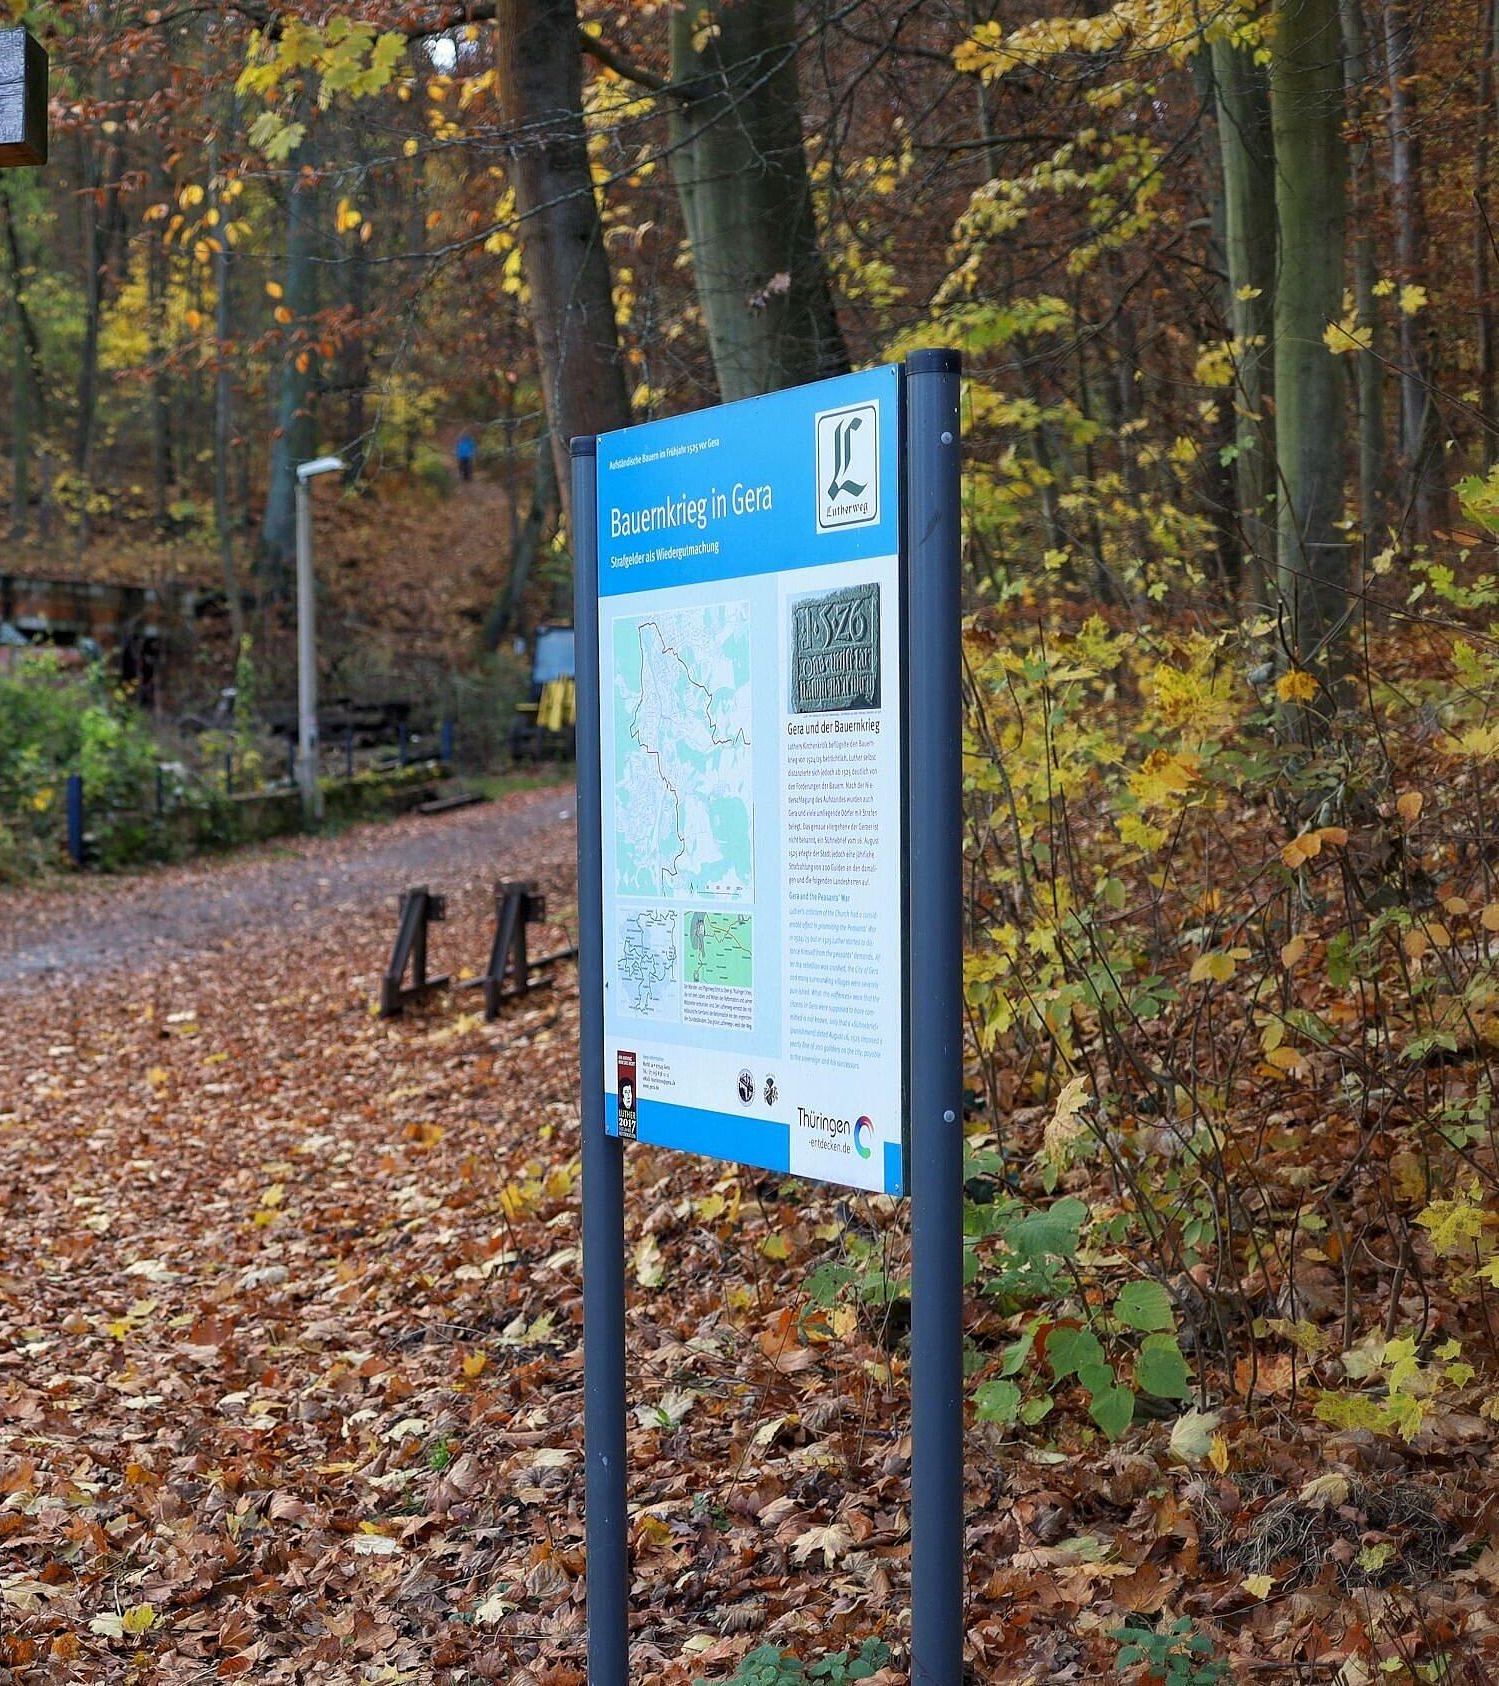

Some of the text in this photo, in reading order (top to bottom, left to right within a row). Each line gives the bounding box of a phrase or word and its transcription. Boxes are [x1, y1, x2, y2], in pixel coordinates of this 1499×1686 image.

[609, 438, 720, 470] Aufständische Bauern im Frühjahr 1525 vor Gera
[611, 483, 772, 538] Bauernkrieg in Gera
[826, 502, 868, 517] Lutherweg
[611, 540, 719, 569] Strafgelder als Wiedergutmachung
[788, 718, 880, 735] Gera und der Bauernkrieg
[618, 1117, 637, 1134] 2017
[619, 1108, 636, 1120] LUTHER
[797, 1106, 851, 1138] Thüringen
